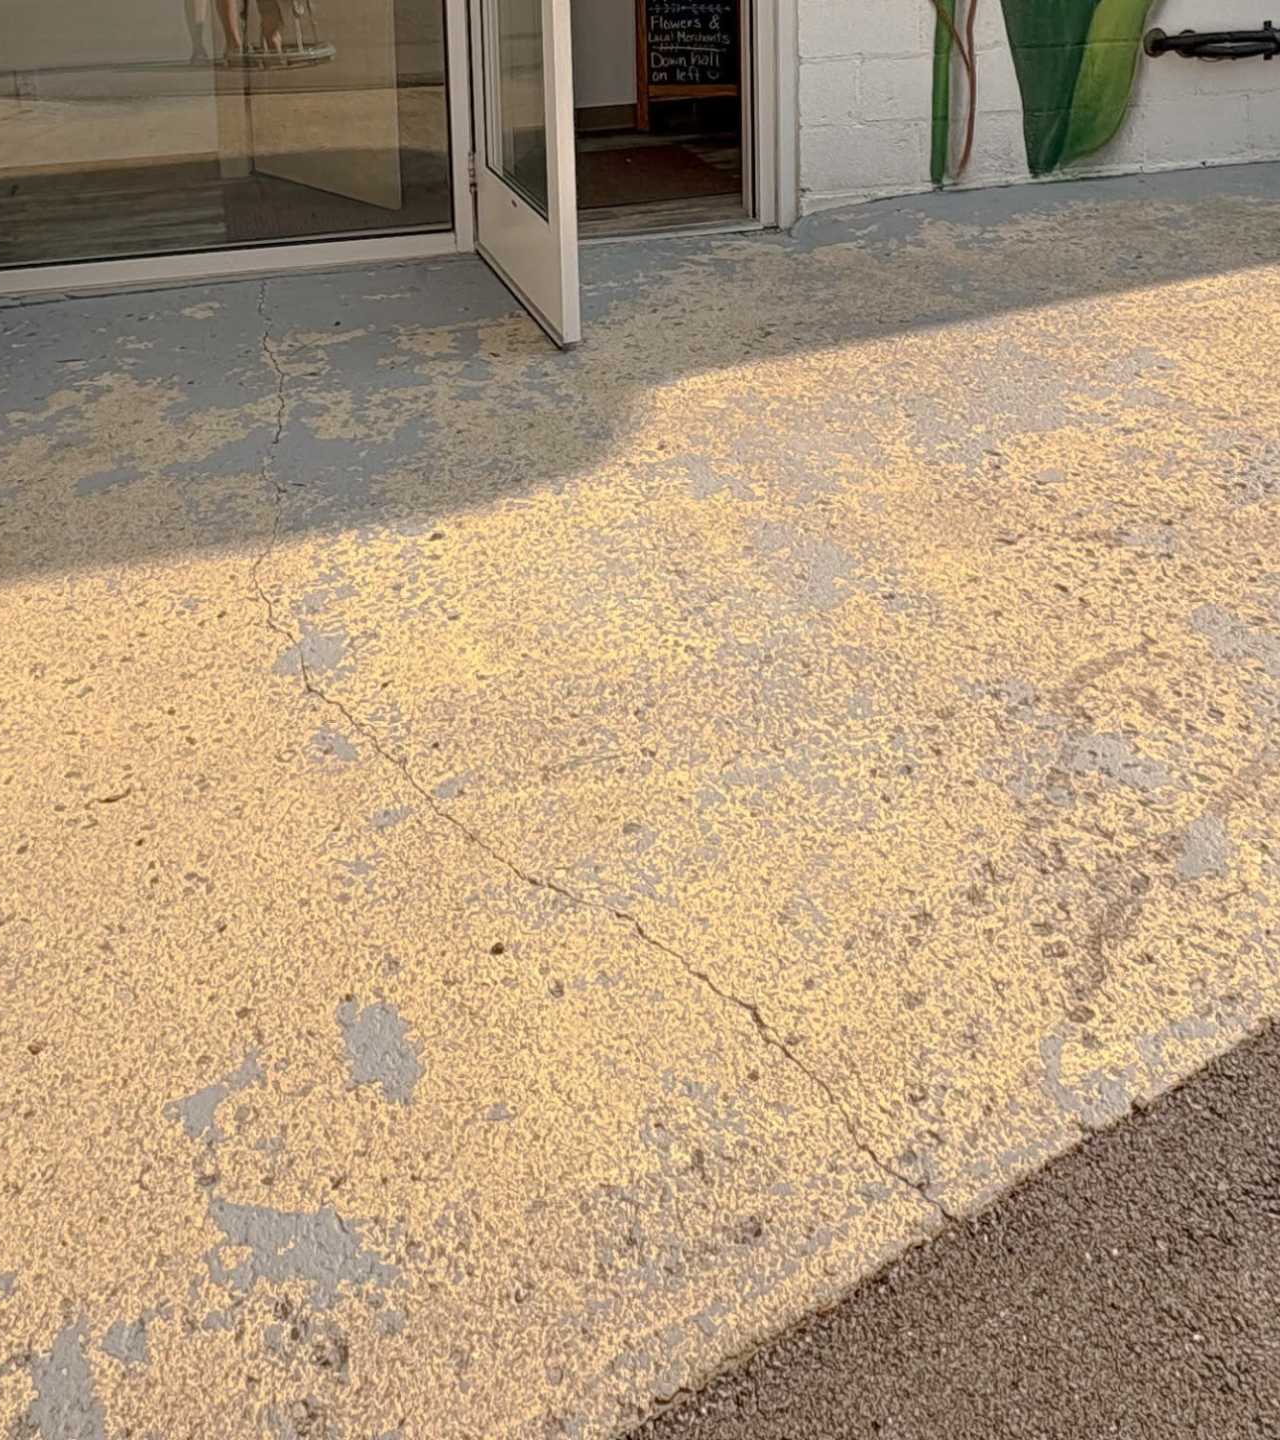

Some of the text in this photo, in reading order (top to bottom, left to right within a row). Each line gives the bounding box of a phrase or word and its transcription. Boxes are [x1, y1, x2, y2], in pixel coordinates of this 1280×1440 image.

[650, 14, 721, 30] Flowers &
[651, 50, 720, 68] Down hall
[652, 65, 701, 82] on left
